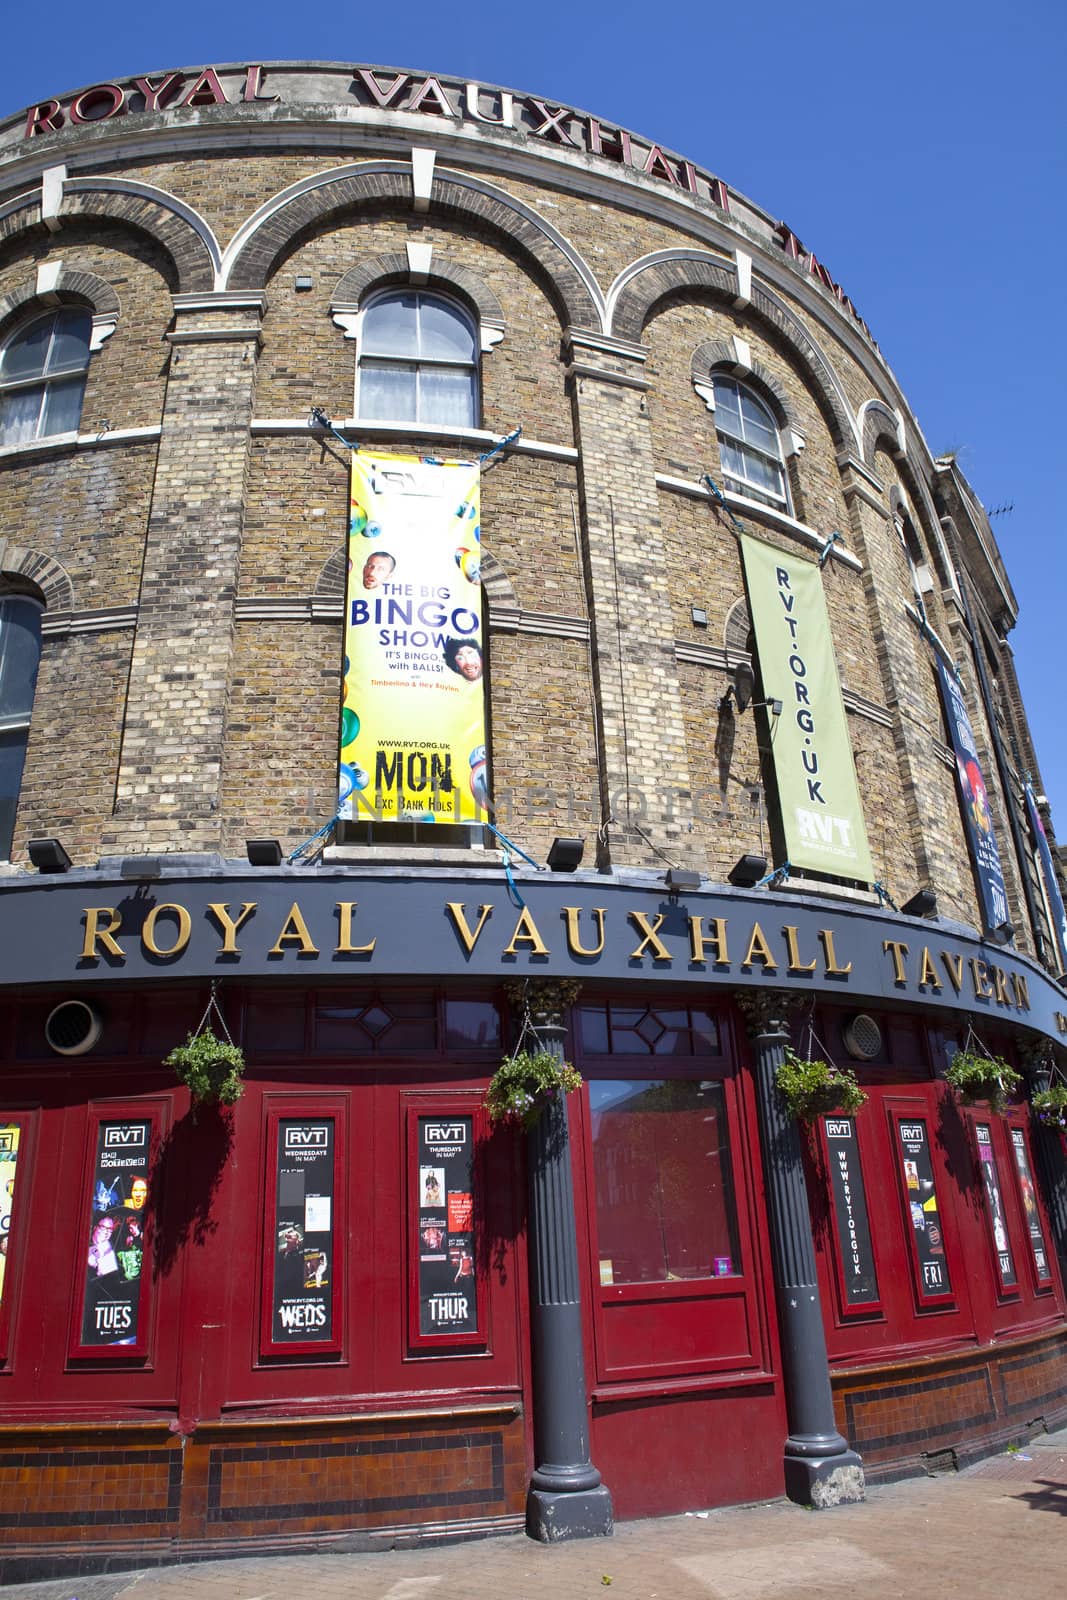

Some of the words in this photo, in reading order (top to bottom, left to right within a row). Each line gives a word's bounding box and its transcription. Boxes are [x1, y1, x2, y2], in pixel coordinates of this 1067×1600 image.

[25, 65, 281, 138] ROYAL
[382, 583, 413, 597] THE
[420, 584, 451, 599] BIG
[352, 598, 480, 635] BINGO
[379, 629, 451, 649] SHOW
[389, 662, 410, 671] with
[412, 663, 445, 673] BALLS!
[377, 739, 451, 750] WWW.RVT.ORG.UK
[375, 750, 457, 793] MON
[796, 808, 851, 847] RVT
[80, 901, 378, 959] ROYAL
[446, 902, 853, 976] VAUXHALL
[883, 939, 1032, 1011] TAVERN
[109, 1130, 141, 1143] RVT
[289, 1131, 324, 1144] RVT
[429, 1127, 462, 1140] RVT
[828, 1124, 848, 1135] RVT
[903, 1128, 920, 1139] RVT
[923, 1264, 942, 1284] FRI
[95, 1305, 132, 1329] TUES
[279, 1304, 327, 1328] WEDS
[428, 1297, 469, 1321] THUR
